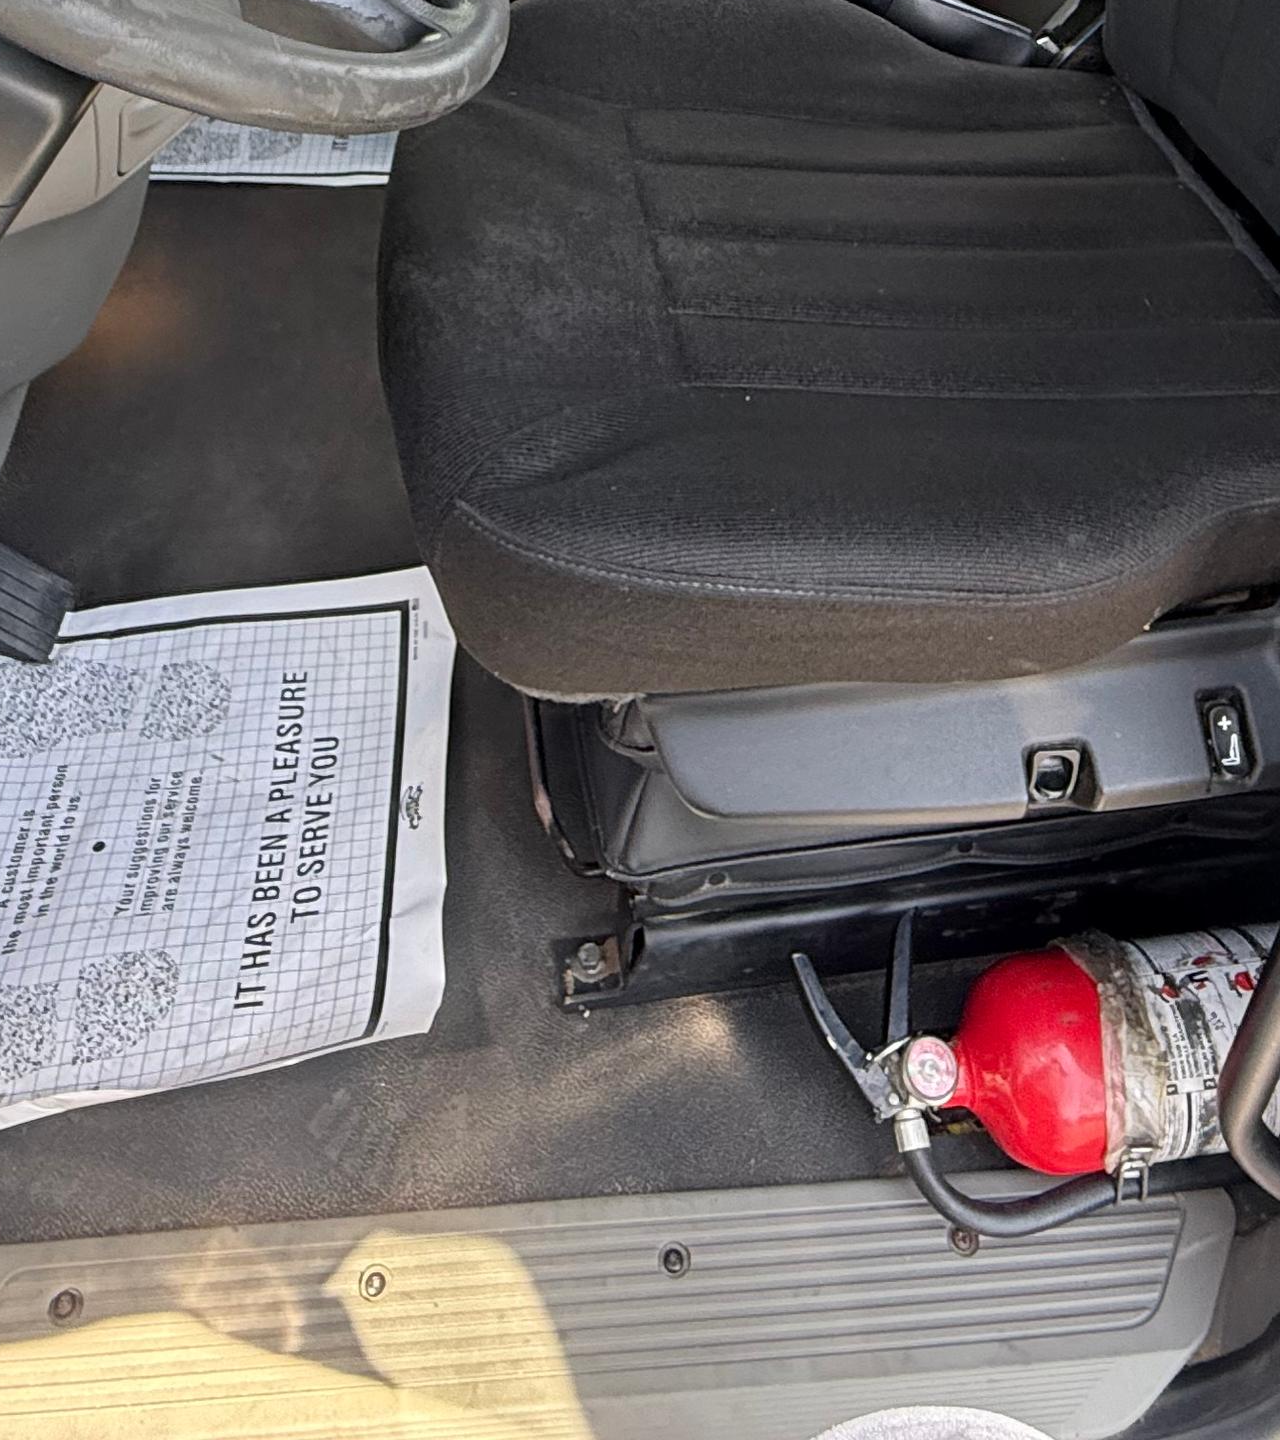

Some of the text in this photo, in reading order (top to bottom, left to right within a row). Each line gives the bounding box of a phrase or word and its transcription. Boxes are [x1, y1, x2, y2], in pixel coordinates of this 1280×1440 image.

[0, 826, 31, 893] customer
[19, 808, 36, 821] is
[0, 764, 69, 954] the most important person
[32, 790, 82, 917] in the world to us.
[113, 777, 161, 915] Your suggestions for
[135, 771, 183, 915] improving our service
[161, 767, 204, 910] are always welcome.
[232, 671, 308, 1010] IT HAS BEEN A PLEASURE
[290, 735, 338, 924] TO SERVE YOU
